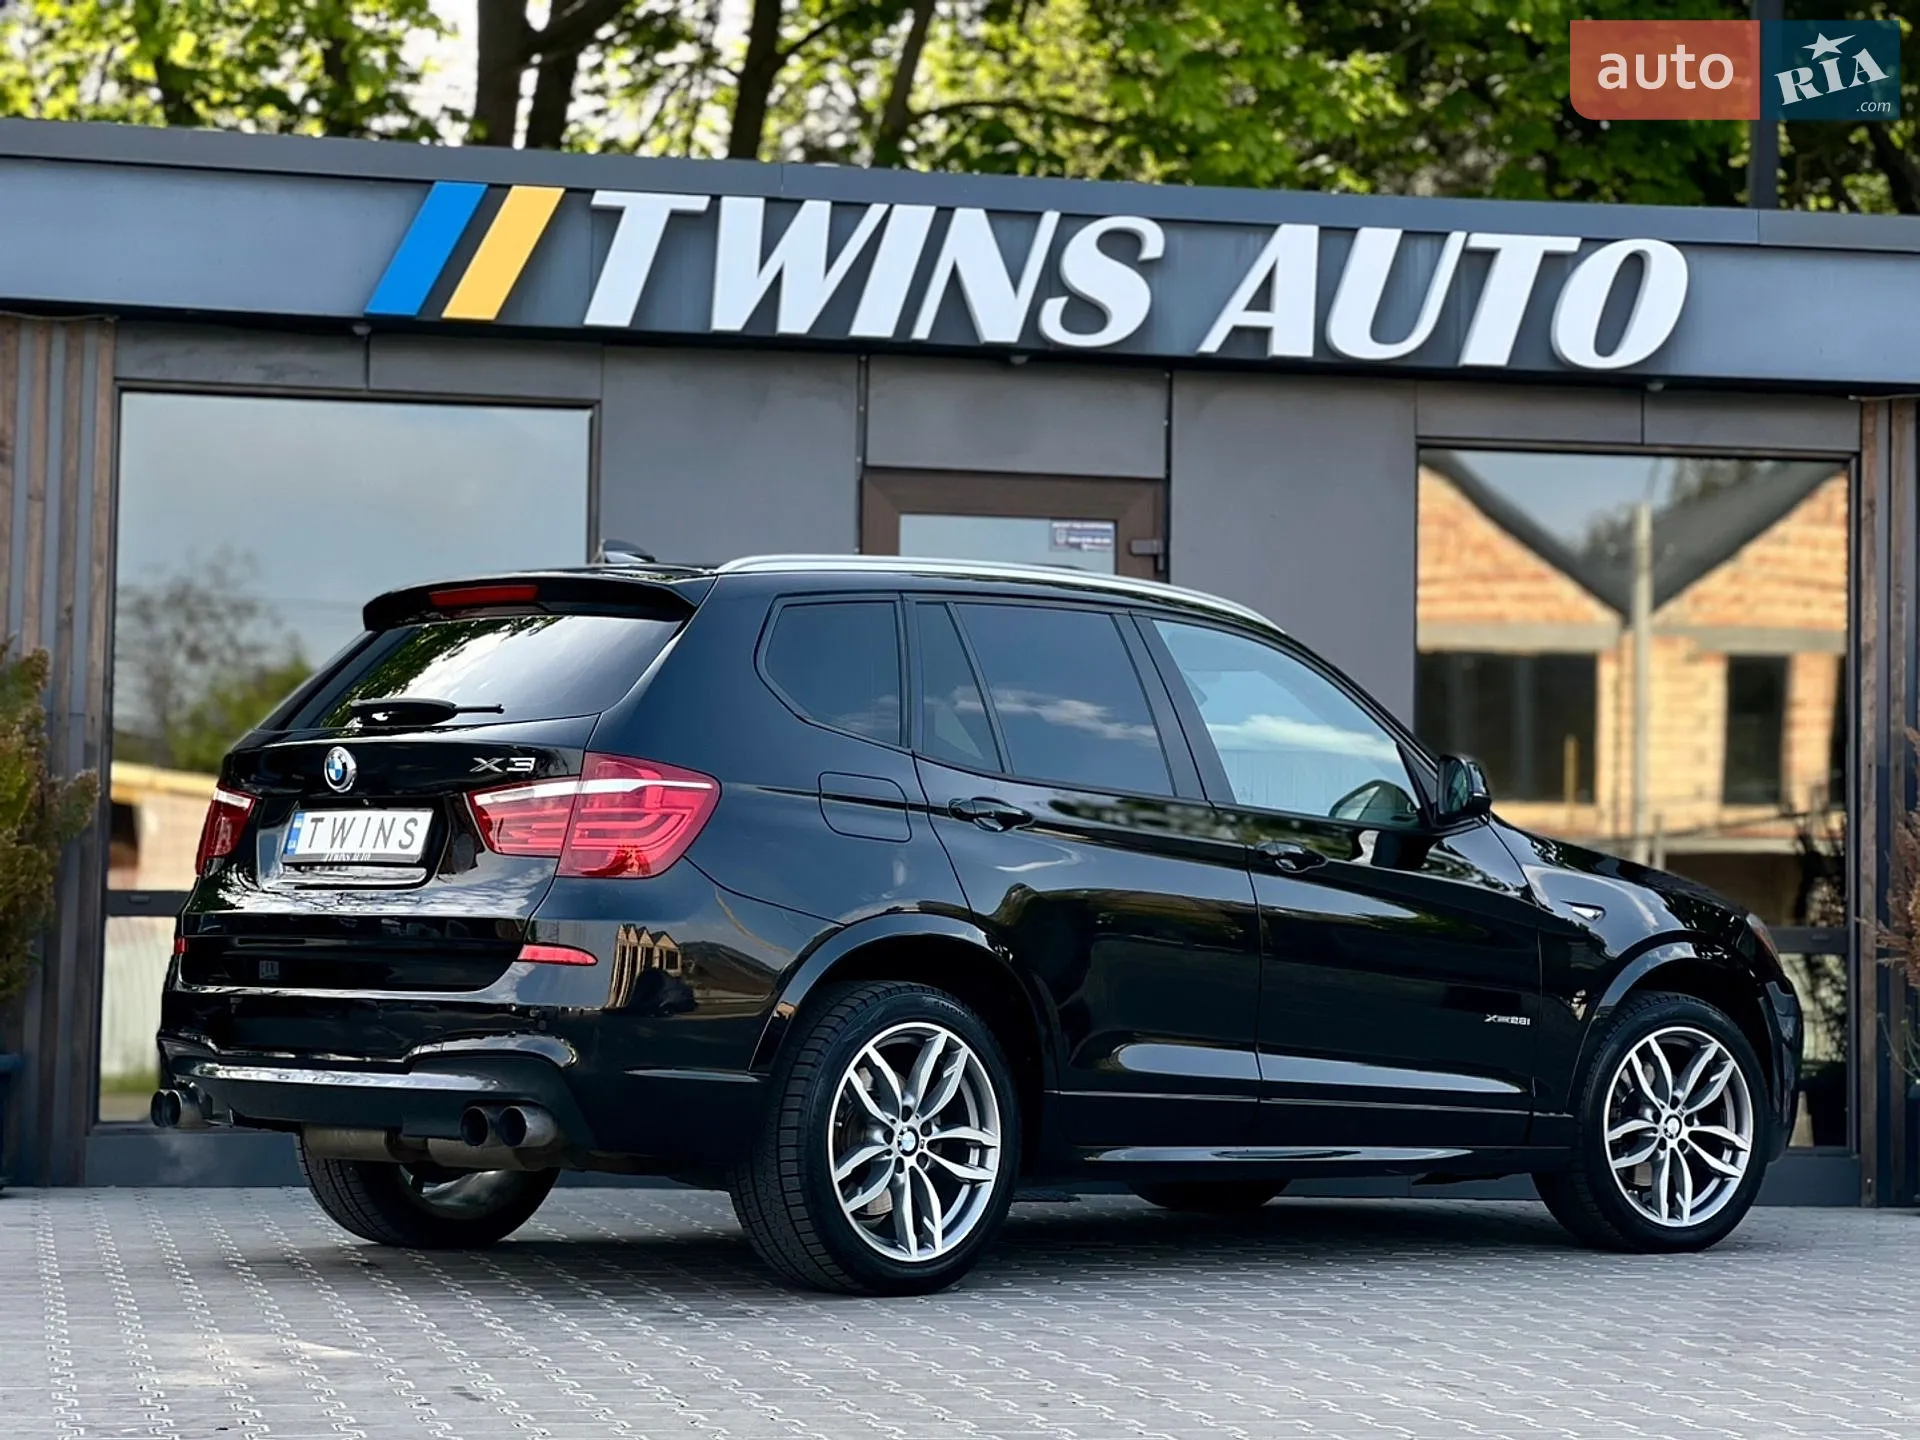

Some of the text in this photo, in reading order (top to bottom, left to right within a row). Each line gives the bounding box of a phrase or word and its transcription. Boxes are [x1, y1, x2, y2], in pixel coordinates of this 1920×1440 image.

[583, 190, 1689, 370] TWINS AUTO
[469, 757, 536, 773] X3
[308, 816, 419, 850] TWINS
